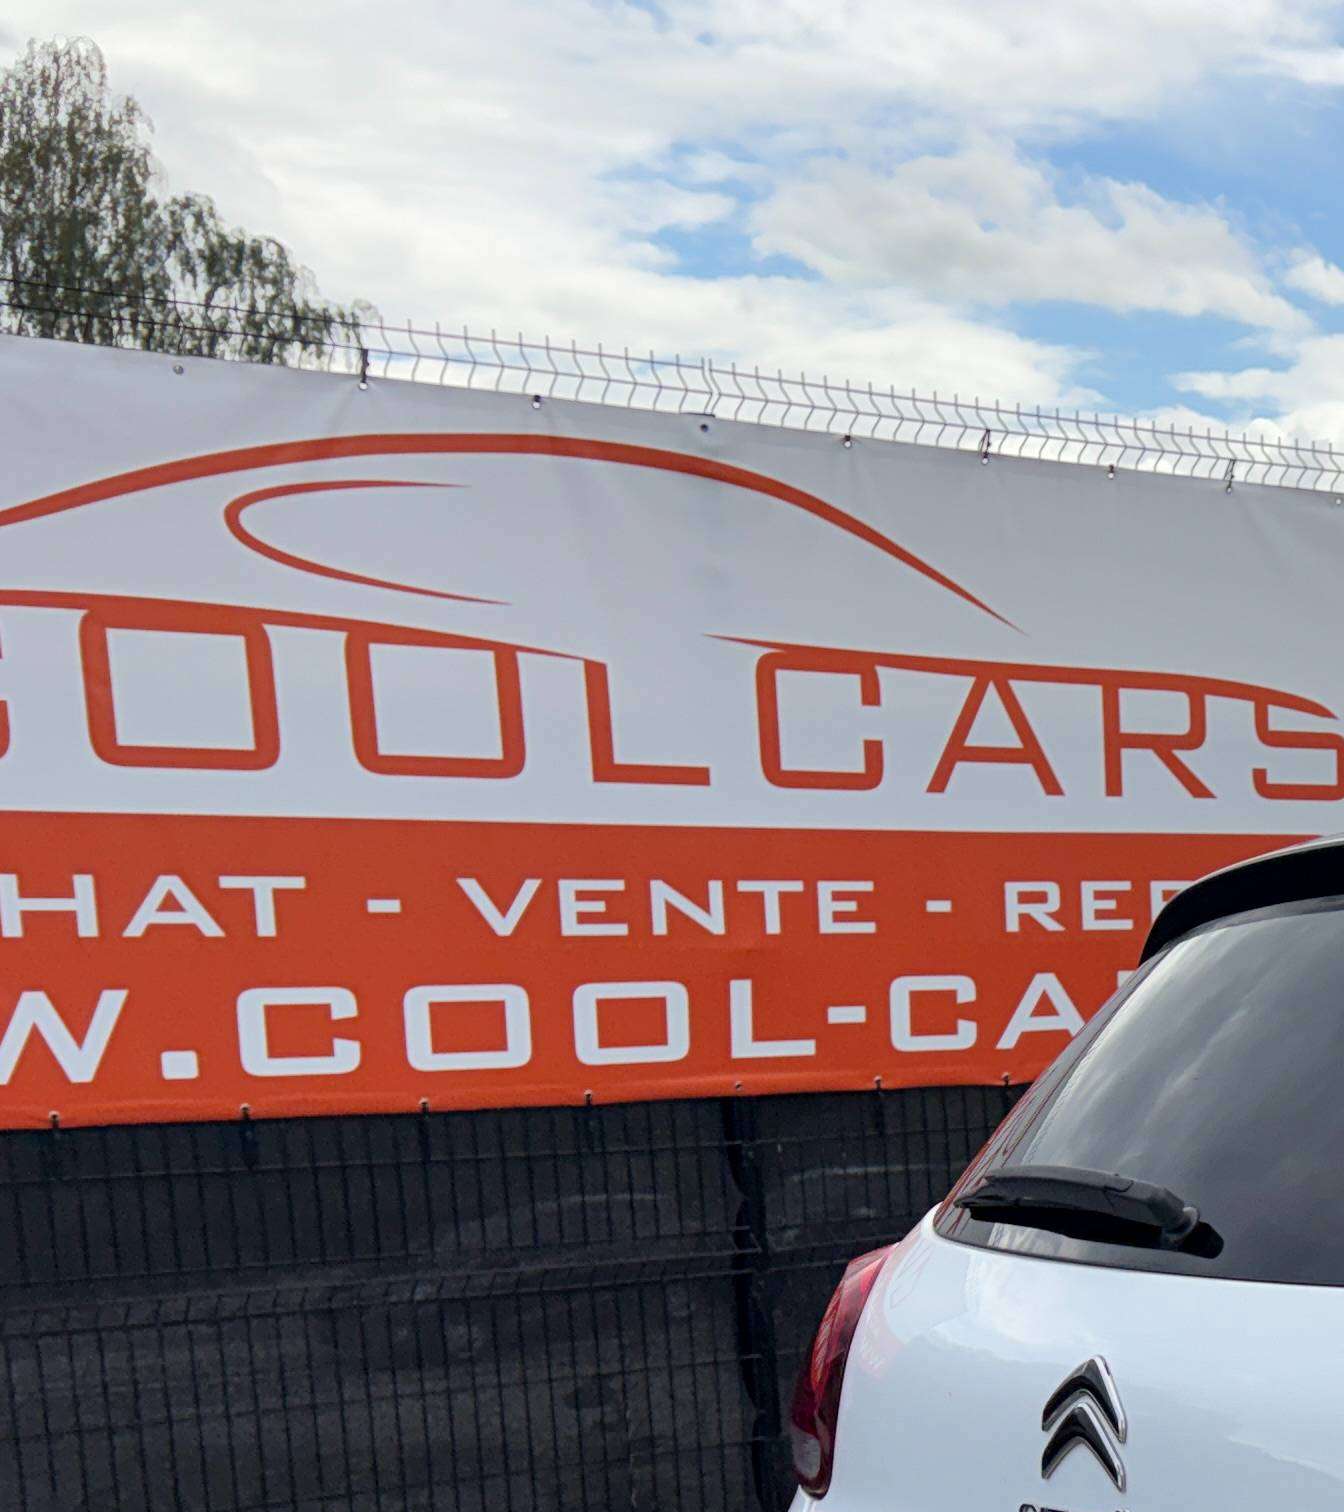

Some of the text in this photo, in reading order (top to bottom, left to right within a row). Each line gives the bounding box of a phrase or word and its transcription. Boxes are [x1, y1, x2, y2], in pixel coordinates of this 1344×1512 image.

[0, 596, 712, 787] OOL
[0, 873, 306, 939] HAT
[456, 876, 877, 937] VENTE
[0, 969, 1138, 1087] W.COOL-CA
